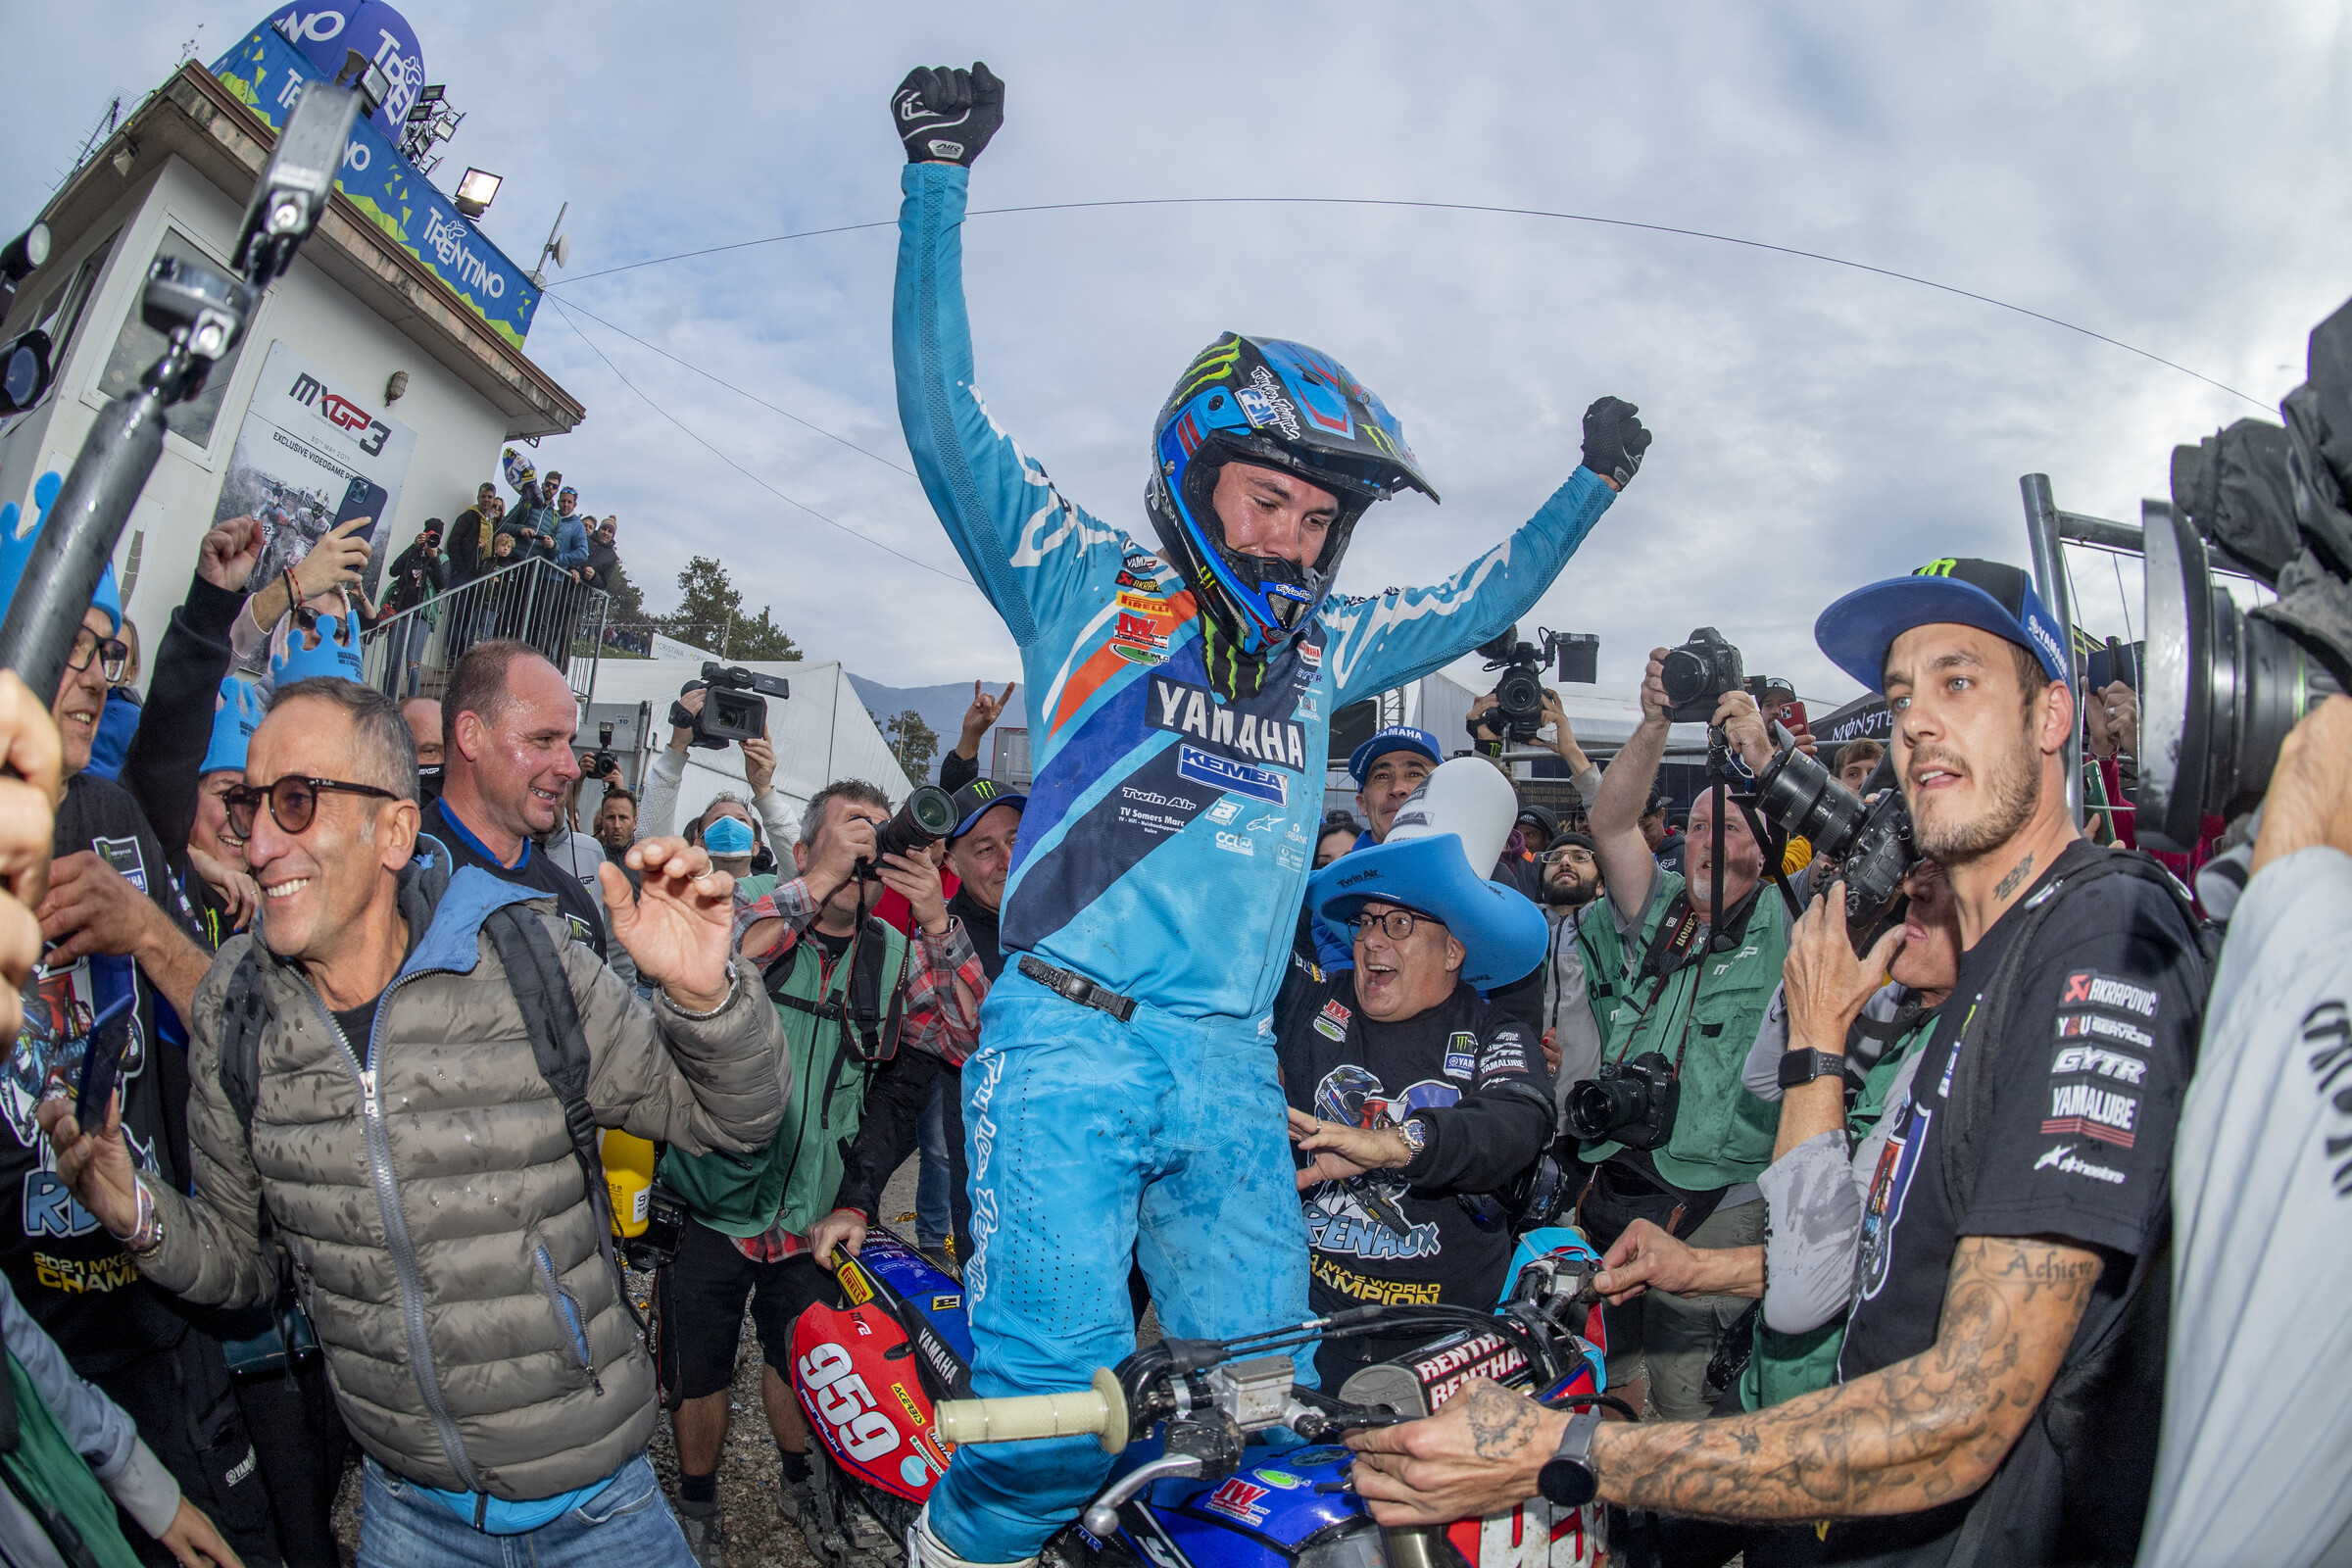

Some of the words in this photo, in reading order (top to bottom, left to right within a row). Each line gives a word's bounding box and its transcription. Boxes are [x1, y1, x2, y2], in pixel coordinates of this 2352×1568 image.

[422, 206, 506, 300] TRENTINO
[272, 431, 310, 458] EXCLUSIVE
[309, 451, 346, 478] VIDEOGAME
[1120, 594, 1170, 613] PIRELLI
[1114, 612, 1157, 638] JW
[657, 641, 685, 658] CRISTINA
[1156, 679, 1304, 769] YAMAHA
[1181, 747, 1283, 790] KEMEA
[1122, 786, 1166, 806] Twin
[1165, 796, 1197, 811] Air
[1119, 807, 1132, 816] TV
[1132, 808, 1163, 823] Somers
[1163, 815, 1185, 827] Marc
[1336, 873, 1362, 889] Twin
[1362, 867, 1380, 880] Air
[1675, 911, 1700, 948] Canon
[1323, 998, 1352, 1020] JW
[1480, 1058, 1525, 1075] YAMALUBE
[2050, 1046, 2147, 1085] GYTR
[2051, 1084, 2137, 1131] YAMALUBE
[32, 1250, 86, 1276] 2021
[1999, 1248, 2095, 1290] Achieve
[1369, 1277, 1442, 1295] WORLD
[917, 1327, 959, 1386] YAMAHA
[798, 1342, 902, 1464] 959
[892, 1385, 923, 1425] ACERBIS
[1210, 1477, 1271, 1507] JW
